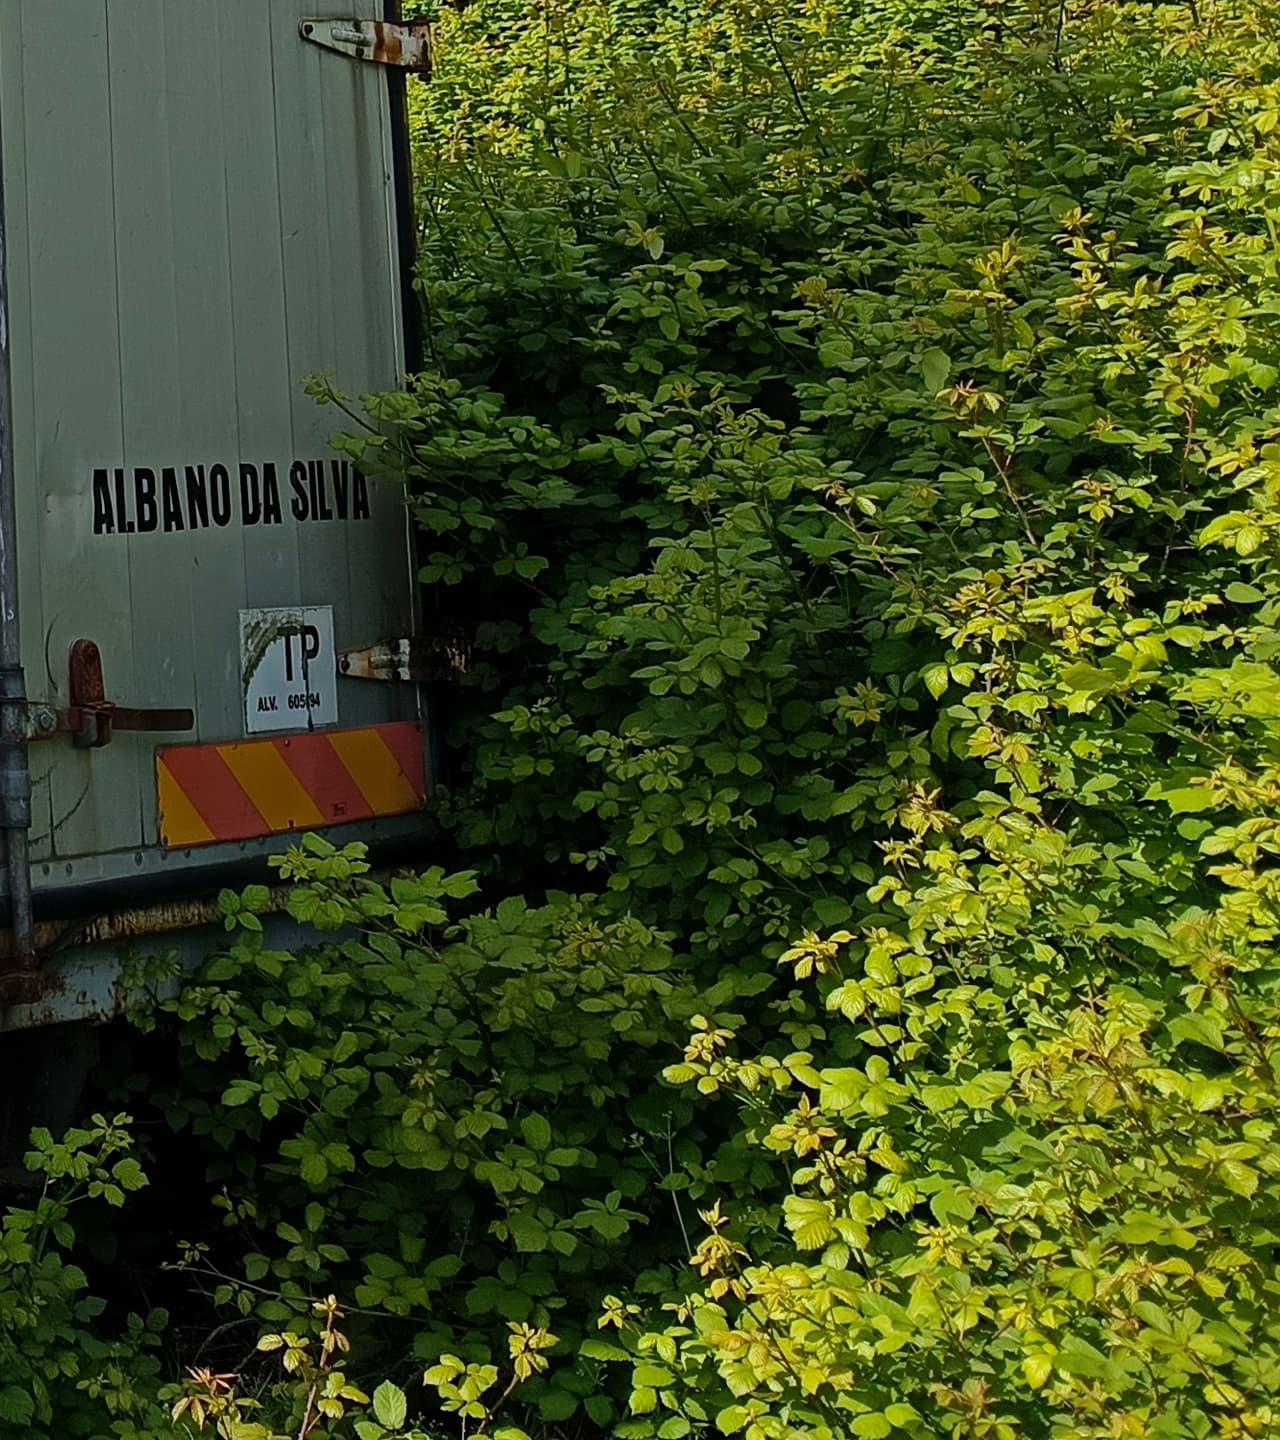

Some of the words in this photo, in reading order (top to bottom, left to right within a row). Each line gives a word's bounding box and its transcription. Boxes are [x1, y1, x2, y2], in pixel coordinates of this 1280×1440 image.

[91, 462, 233, 536] ALBANO
[239, 461, 283, 527] DA
[289, 459, 372, 522] SILVA
[276, 623, 321, 683] TP
[256, 695, 279, 713] ALV.
